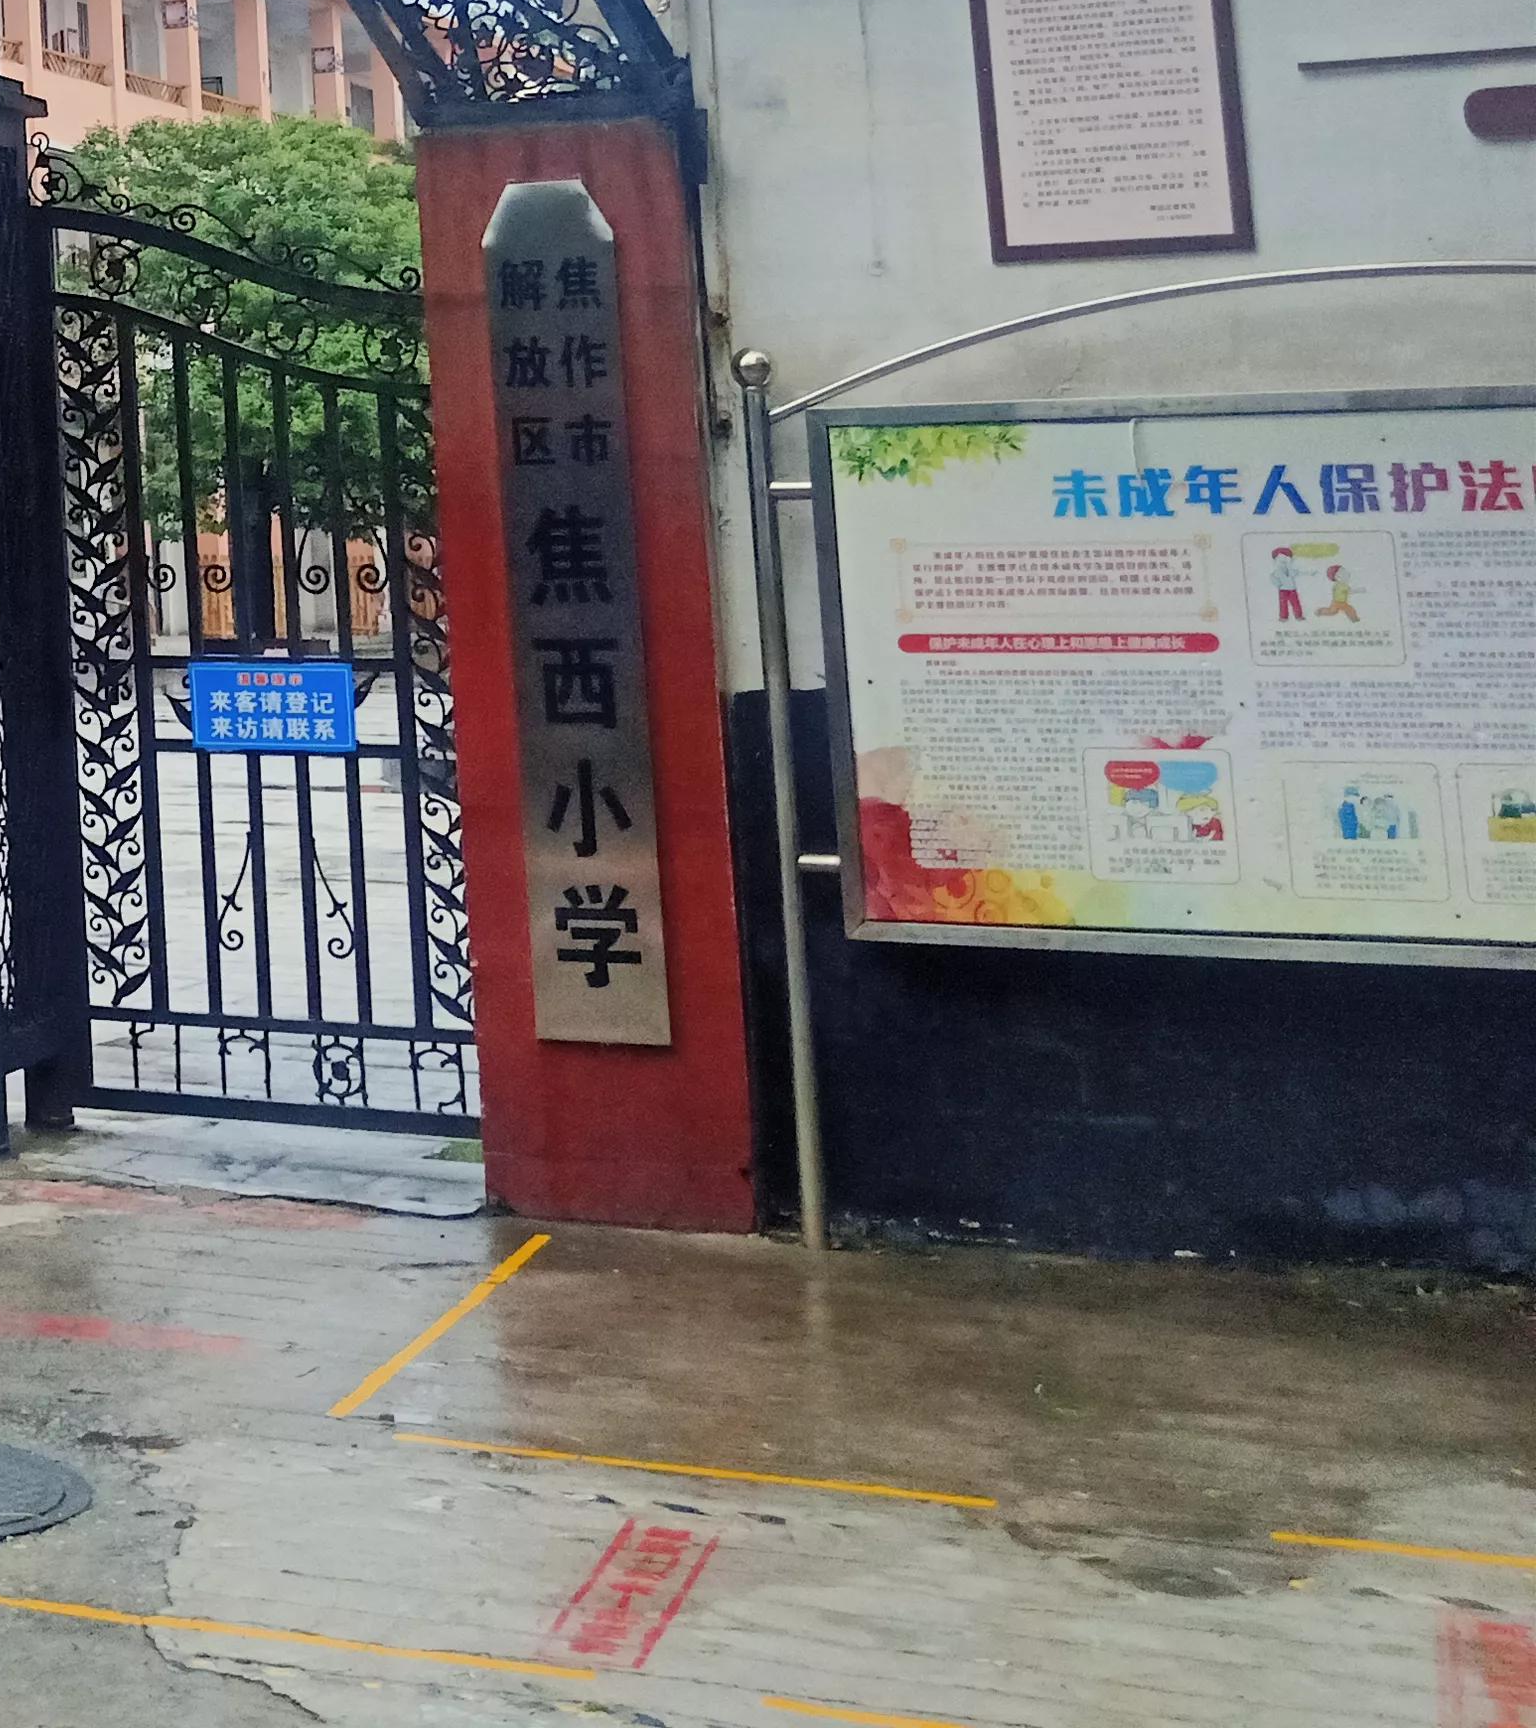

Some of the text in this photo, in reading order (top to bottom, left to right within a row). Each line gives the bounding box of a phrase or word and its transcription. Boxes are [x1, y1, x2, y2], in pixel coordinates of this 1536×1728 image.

[497, 258, 556, 466] 解放区
[555, 256, 612, 466] 焦作市
[1052, 459, 1536, 519] 未成年人保护法
[209, 689, 335, 714] 来客请登记
[237, 672, 303, 686] 温馨提示
[211, 715, 336, 741] 来访请联系
[527, 504, 642, 988] 焦西小学
